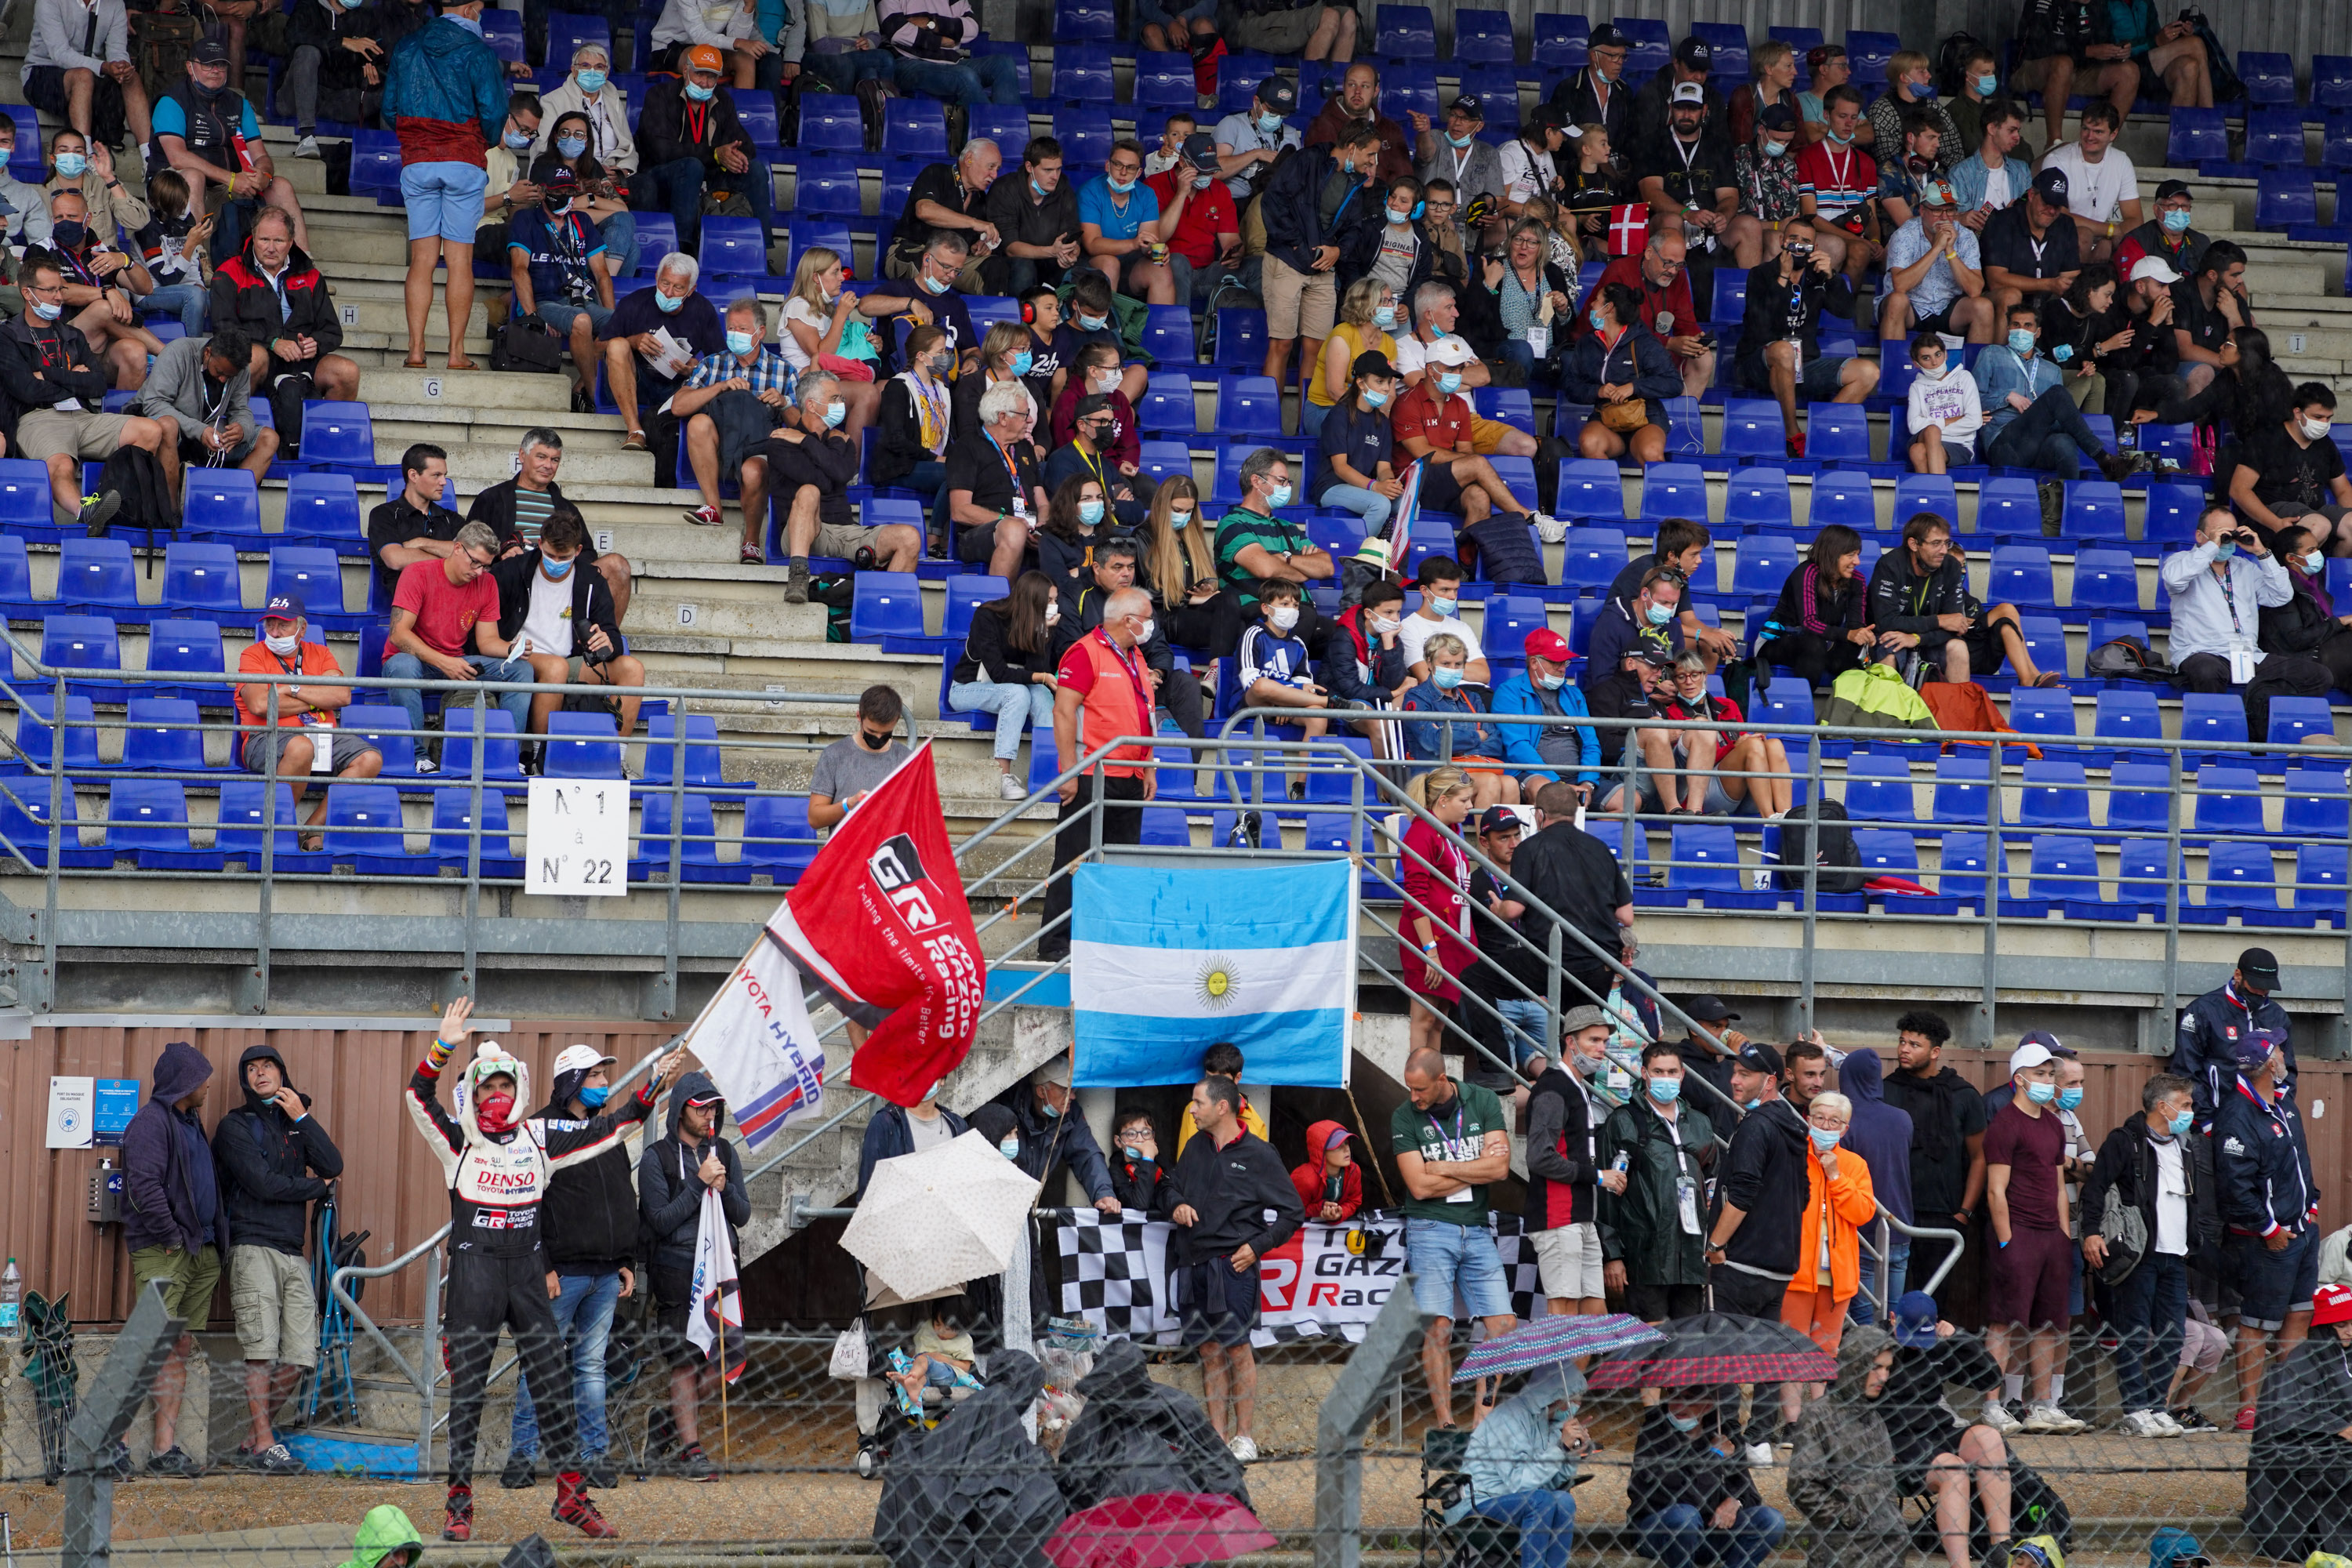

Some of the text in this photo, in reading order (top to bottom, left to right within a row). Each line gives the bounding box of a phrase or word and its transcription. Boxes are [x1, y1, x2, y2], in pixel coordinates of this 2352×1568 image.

[556, 169, 571, 177] 24h
[1941, 185, 1950, 194] 69
[2051, 180, 2066, 189] 24h
[531, 252, 549, 263] LE
[345, 309, 354, 323] H
[2296, 338, 2299, 350] I
[1029, 351, 1059, 373] 24h
[428, 382, 437, 396] G
[1936, 388, 1965, 398] PLAYERS
[600, 535, 608, 550] E
[270, 597, 289, 608] 24h
[681, 609, 691, 623] D
[595, 791, 605, 815] 1
[1498, 808, 1515, 818] 24h
[575, 829, 583, 845] à
[543, 855, 612, 884] N° 22
[871, 845, 937, 930] GR
[858, 882, 881, 925] Pshing
[881, 927, 899, 947] the
[898, 946, 927, 982] limits
[917, 1006, 932, 1045] Better
[953, 931, 981, 1009] TOYO
[922, 938, 956, 1040] Racing
[938, 934, 970, 1039] GAZOO
[735, 964, 820, 1105] YOTA HYBRID
[1421, 1134, 1484, 1157] LE MANS
[477, 1171, 535, 1188] DENSO
[477, 1185, 506, 1195] TOYOTA
[509, 1207, 537, 1218] TOYOTA
[474, 1216, 506, 1229] GR
[506, 1221, 534, 1229] Racing
[1307, 1283, 1392, 1307] Rac
